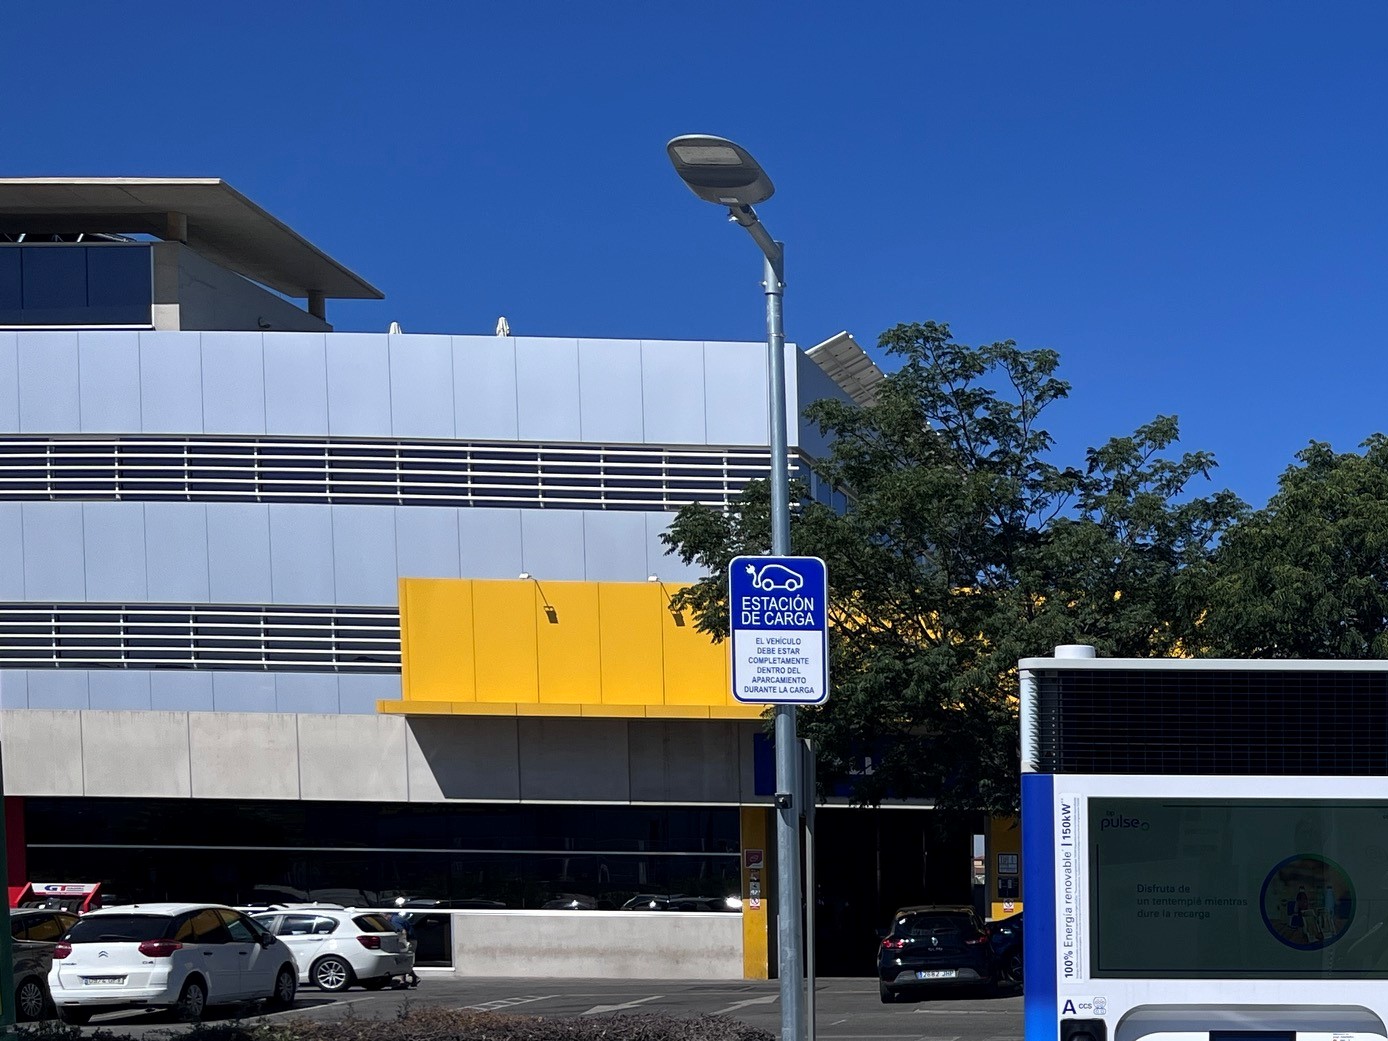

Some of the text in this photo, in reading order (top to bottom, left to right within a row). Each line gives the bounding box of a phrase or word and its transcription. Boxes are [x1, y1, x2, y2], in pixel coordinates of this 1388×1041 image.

[742, 594, 814, 611] ESTACIÓN
[742, 612, 815, 626] DE CARGA
[755, 636, 802, 645] EL VEHÍCULO
[757, 647, 800, 655] DEBE ESTAR
[748, 657, 810, 665] COMPLETAMENTE
[751, 676, 807, 684] APARCAMIENTO
[744, 685, 815, 694] DURANTE LA CARGA
[1101, 815, 1140, 831] pulse
[1137, 883, 1191, 894] Disfruta de
[1137, 896, 1249, 909] un tentempié mientras
[1137, 909, 1211, 920] dure la recarga
[1063, 907, 1075, 948] Energía
[1063, 950, 1074, 979] 100%
[1062, 999, 1077, 1015] A
